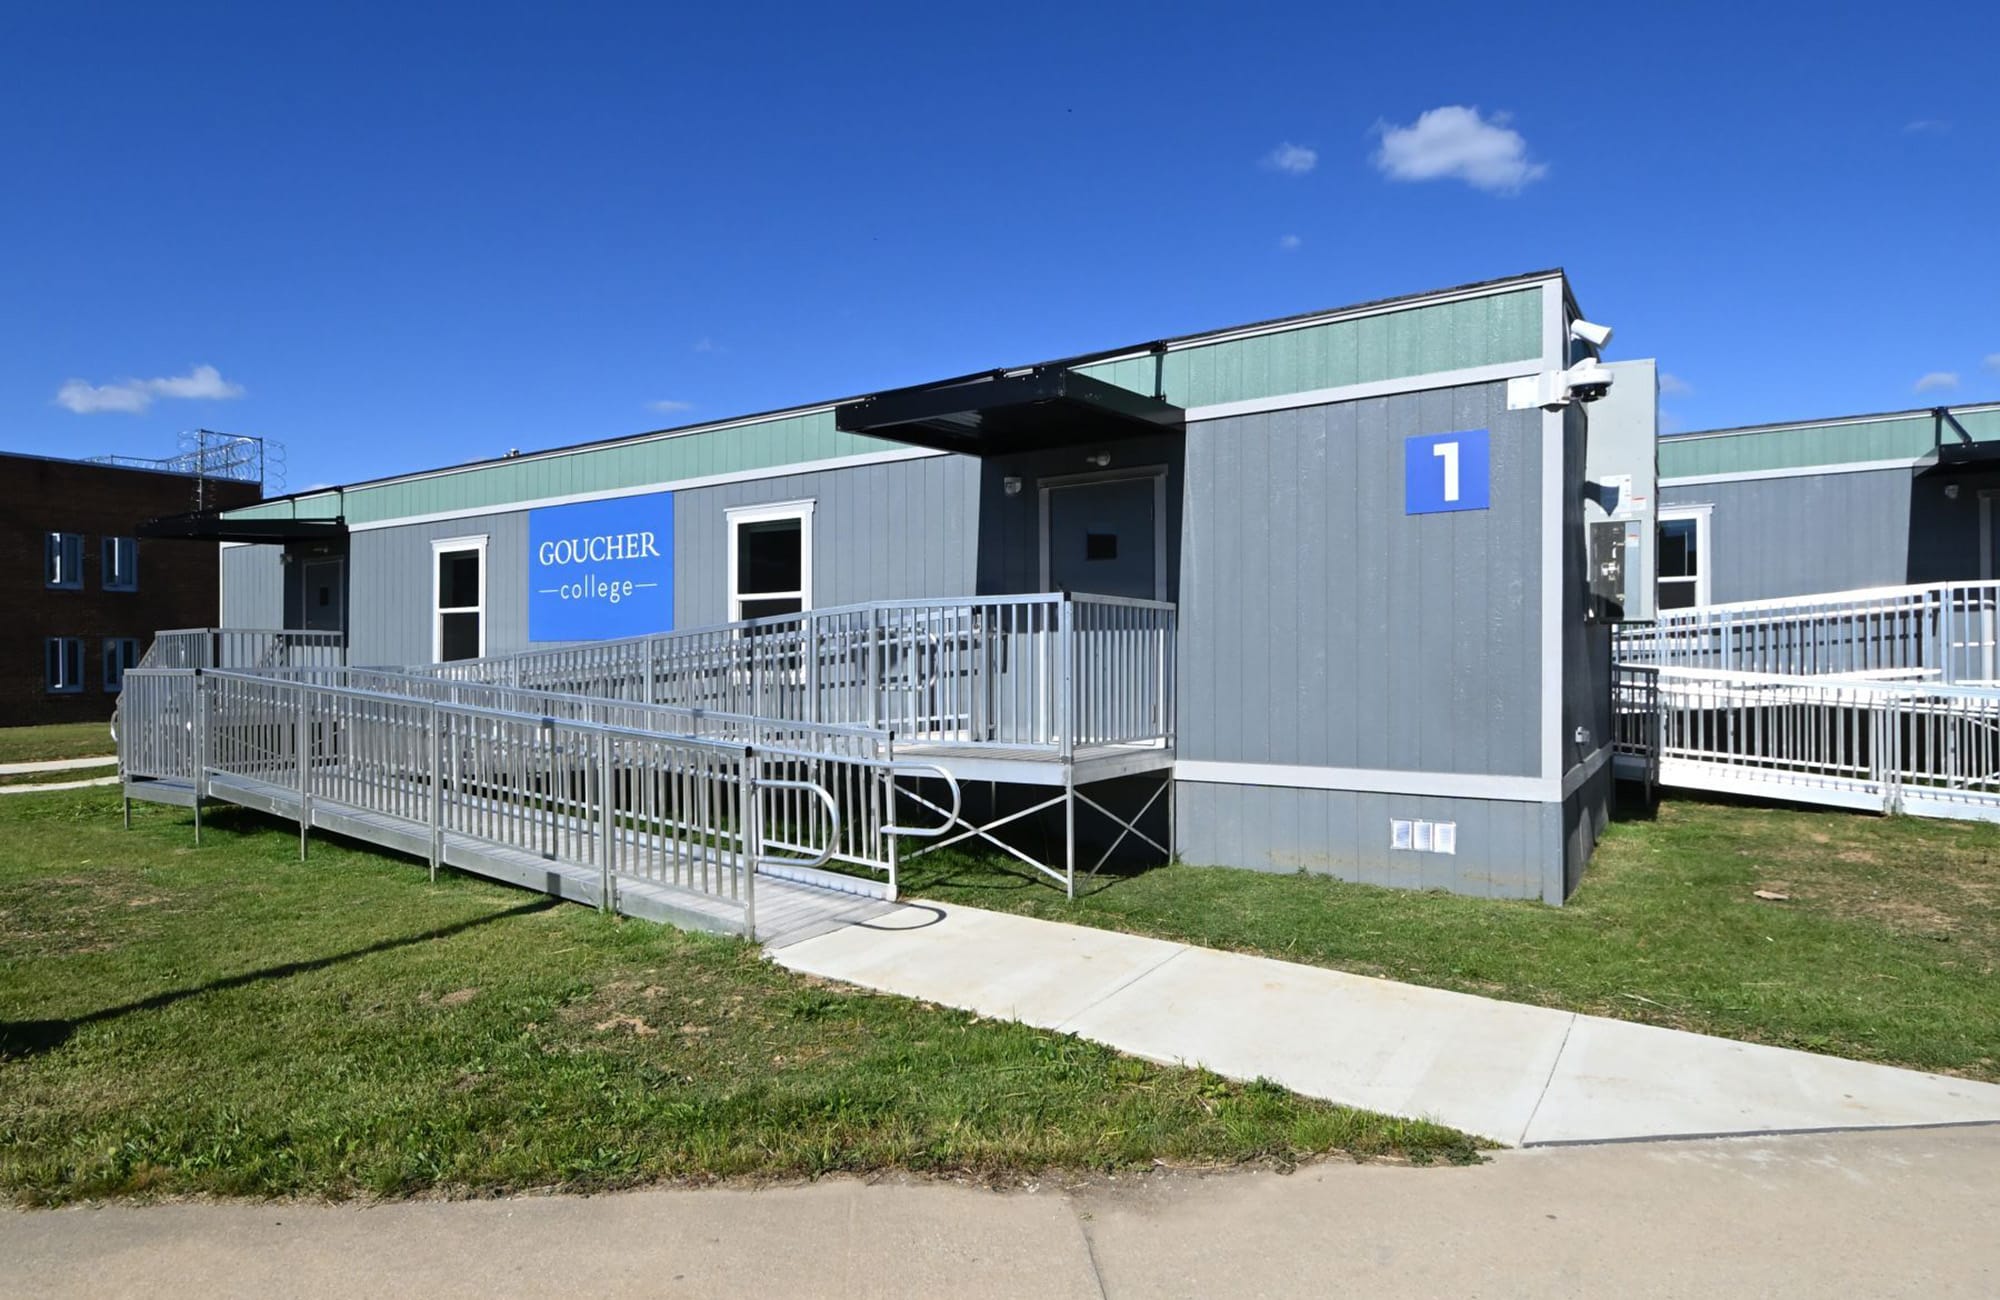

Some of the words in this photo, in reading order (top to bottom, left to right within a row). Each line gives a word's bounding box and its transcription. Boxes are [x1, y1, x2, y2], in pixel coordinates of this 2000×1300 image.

[1433, 442, 1459, 502] 1
[539, 532, 661, 566] GOUCHER
[560, 573, 633, 604] college
